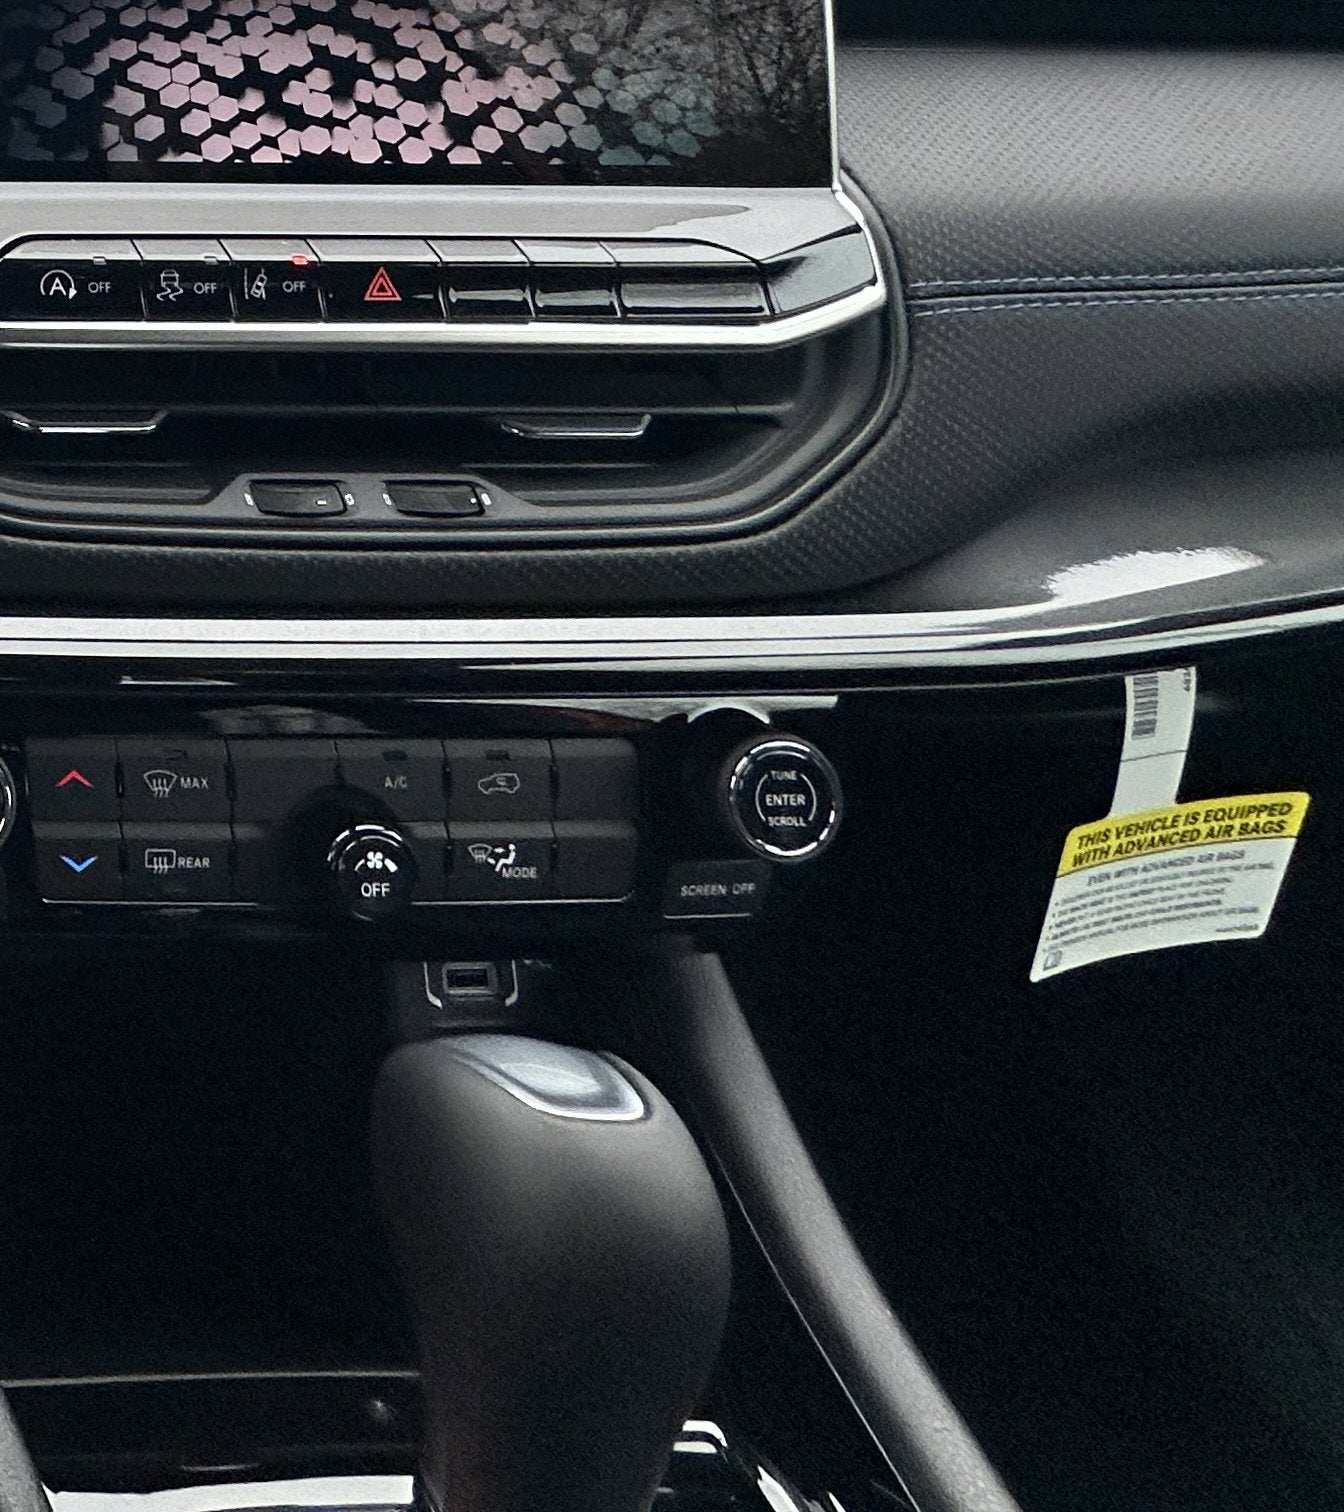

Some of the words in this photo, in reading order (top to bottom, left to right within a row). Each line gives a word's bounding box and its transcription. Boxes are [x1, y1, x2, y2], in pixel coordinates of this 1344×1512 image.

[87, 281, 111, 294] OFF
[193, 282, 217, 295] OFF
[282, 280, 307, 294] OFF
[384, 775, 408, 789] A/C
[770, 770, 798, 782] TUNE
[180, 777, 209, 790] MAX
[765, 793, 806, 807] ENTER
[767, 815, 806, 828] SCROLL
[1077, 828, 1112, 850] THIS
[1115, 814, 1179, 839] VEHICLE
[1182, 810, 1200, 825] IS
[1203, 802, 1293, 824] EQUIPPED
[1071, 847, 1110, 868] WITH
[1112, 829, 1202, 856] ADVANCED
[1204, 824, 1234, 839] AIR
[1237, 819, 1287, 836] BAGS
[177, 856, 210, 869] REAR
[502, 866, 538, 879] MODE
[361, 882, 390, 898] OFF
[680, 883, 727, 897] SCREEN
[732, 883, 756, 896] OFF
